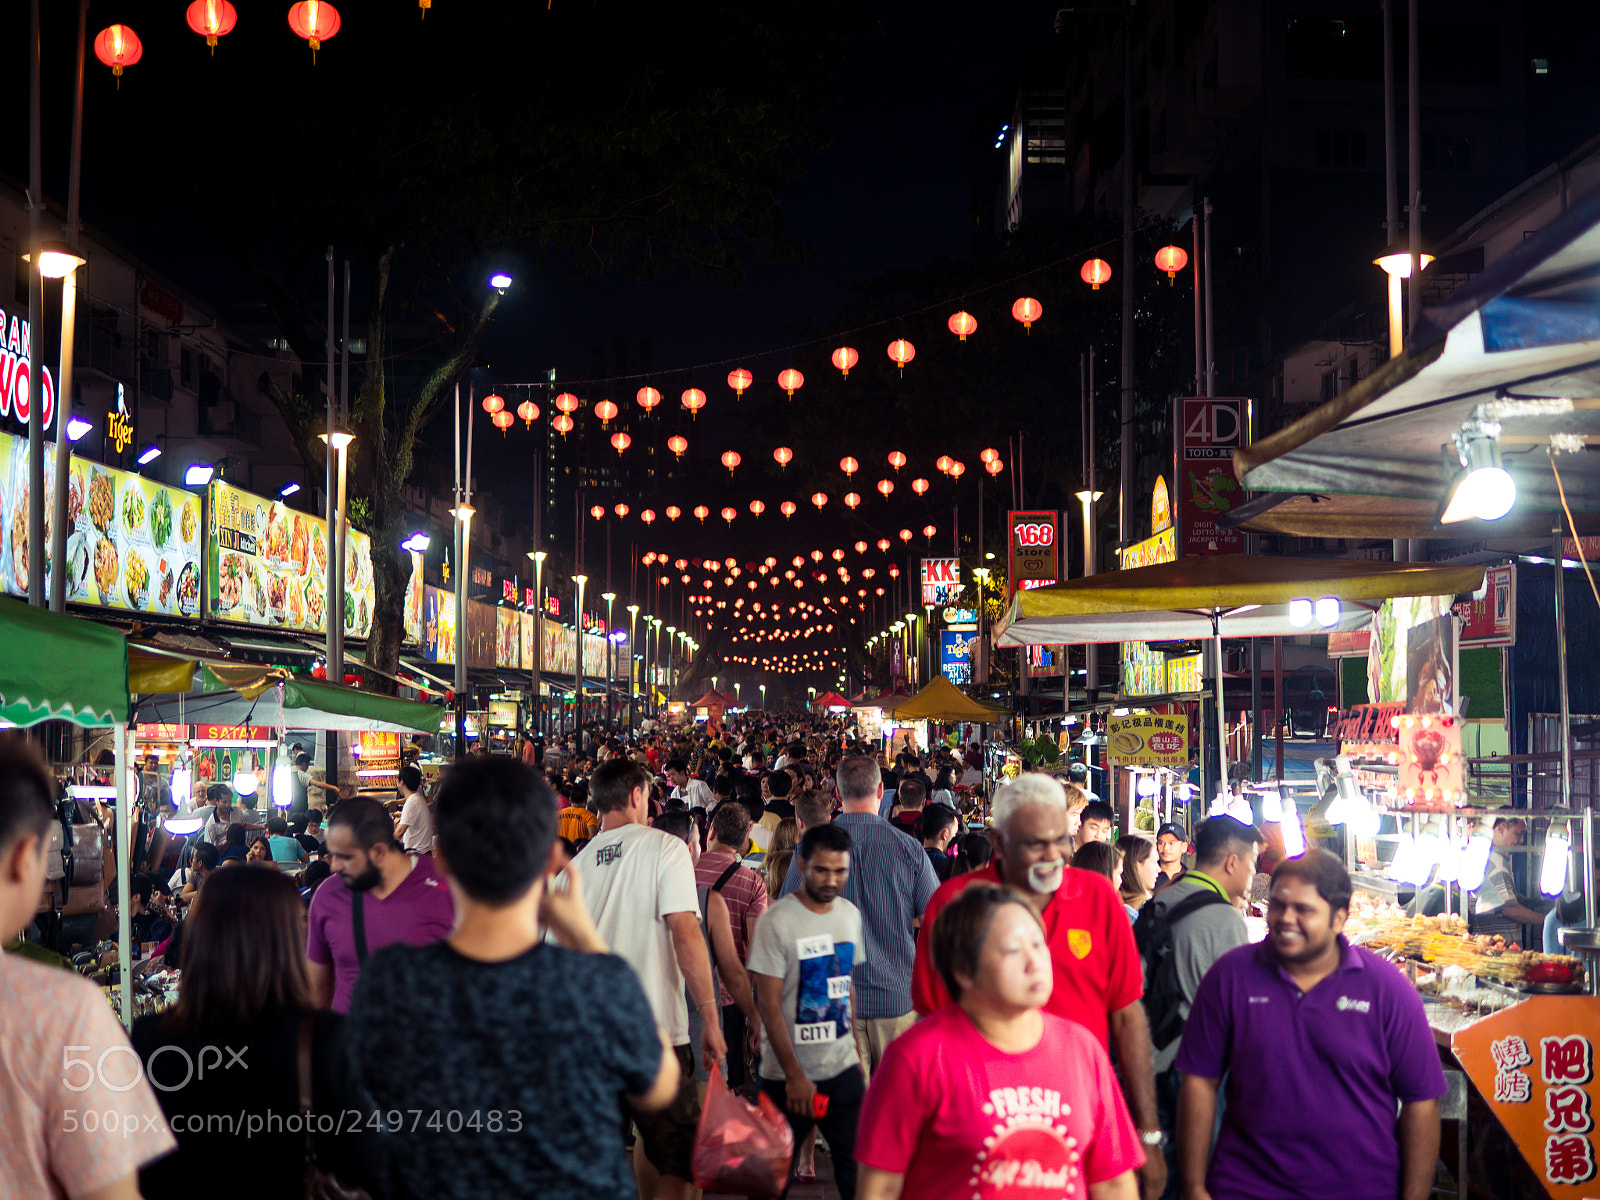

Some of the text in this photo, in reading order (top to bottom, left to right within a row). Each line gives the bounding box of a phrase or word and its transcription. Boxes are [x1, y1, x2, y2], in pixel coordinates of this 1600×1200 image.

[108, 411, 133, 453] Tiger
[1185, 404, 1240, 443] 4D
[1187, 449, 1214, 457] TOTO
[1014, 523, 1054, 547] 168
[1194, 521, 1214, 529] DIGIT
[220, 528, 232, 549] XIN
[1016, 548, 1051, 557] Store
[926, 560, 955, 581] KK
[1024, 579, 1040, 590] 24
[208, 726, 258, 740] SATAY
[1333, 708, 1364, 740] Fried
[1361, 707, 1374, 739] &
[800, 1025, 831, 1041] CITY
[988, 1085, 1061, 1120] FRESH
[1540, 1034, 1594, 1184] 肥兄弟
